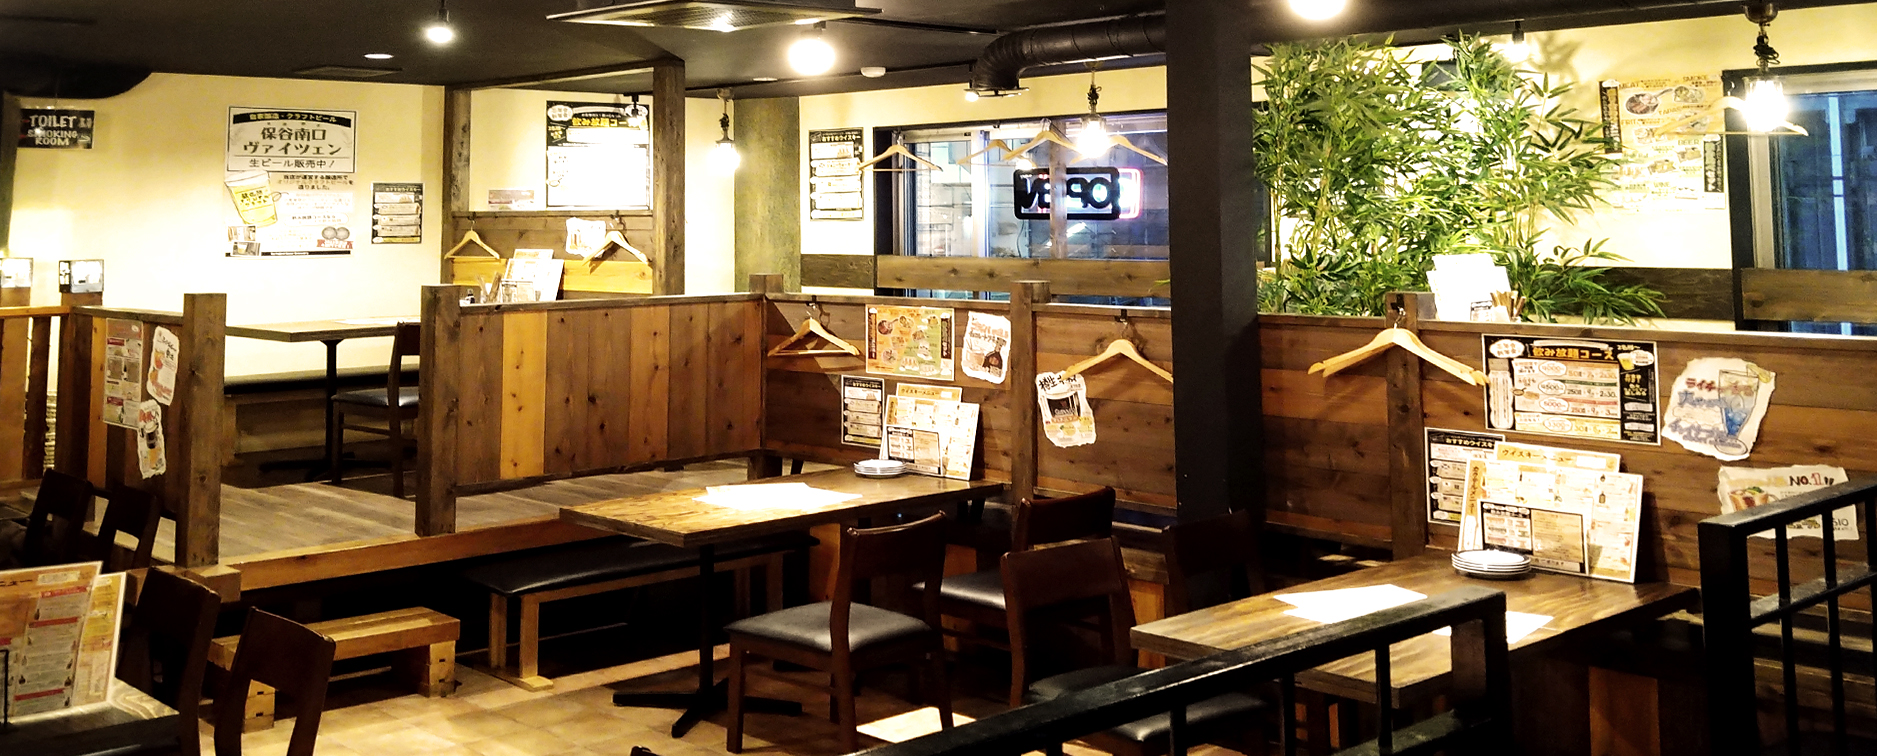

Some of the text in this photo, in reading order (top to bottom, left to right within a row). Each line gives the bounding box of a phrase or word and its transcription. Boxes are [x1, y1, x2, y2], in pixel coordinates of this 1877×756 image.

[29, 115, 77, 128] TOILET
[27, 128, 78, 139] SMOKING
[261, 127, 326, 141] 保谷南口
[35, 138, 70, 146] ROOM
[243, 141, 342, 155] ヴァイツェン
[1533, 347, 1614, 361] 飲み放題コース
[1446, 438, 1494, 448] おすすめウイスキ
